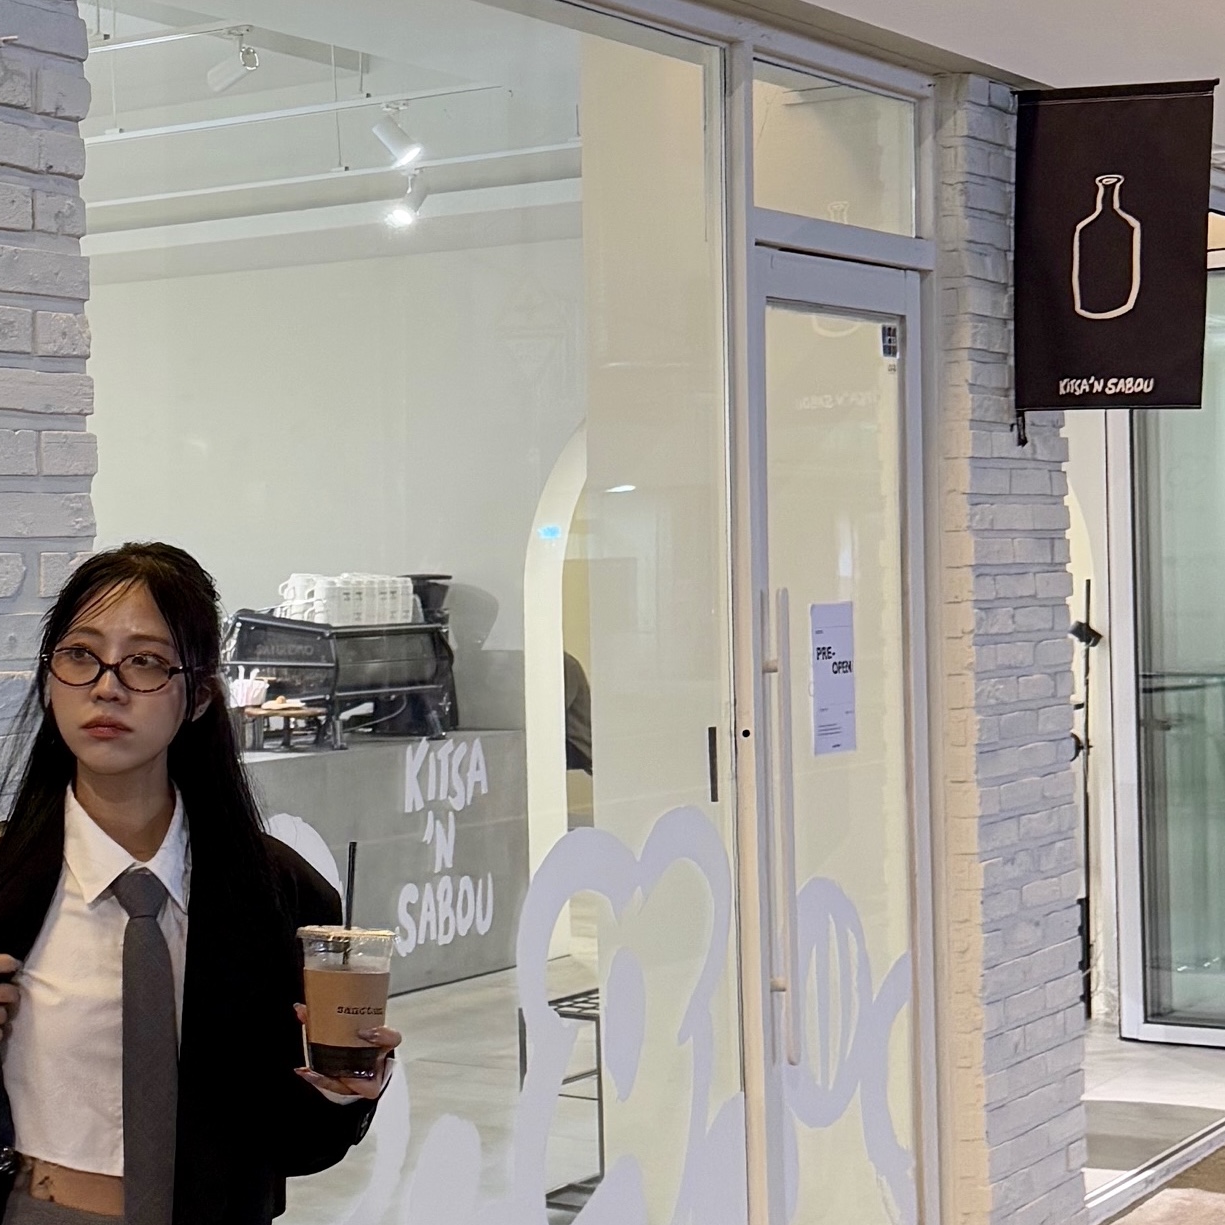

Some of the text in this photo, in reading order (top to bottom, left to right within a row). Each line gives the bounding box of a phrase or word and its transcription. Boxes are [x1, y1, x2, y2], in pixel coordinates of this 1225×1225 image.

[1104, 376, 1155, 395] SABOU
[816, 646, 836, 661] PRE-
[831, 660, 853, 675] OPEN
[404, 736, 488, 813] KITSA
[393, 871, 493, 957] SABOU
